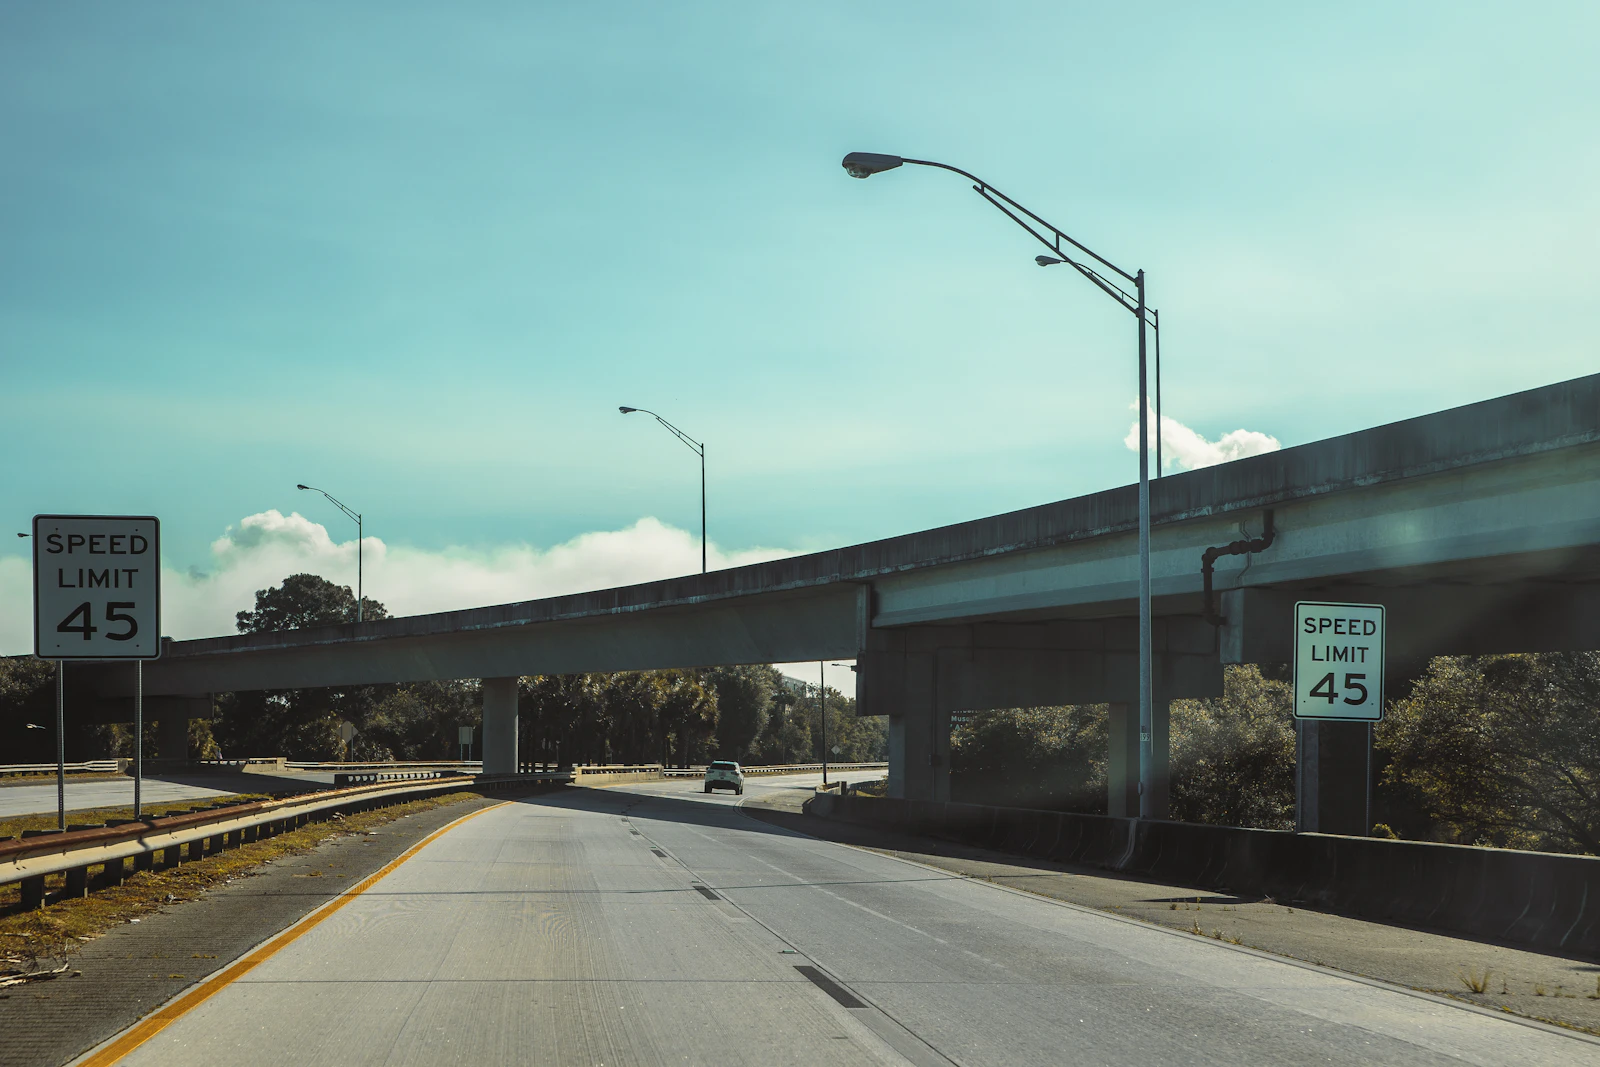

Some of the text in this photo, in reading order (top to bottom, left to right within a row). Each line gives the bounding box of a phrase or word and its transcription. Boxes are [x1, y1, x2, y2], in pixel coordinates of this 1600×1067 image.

[46, 533, 148, 555] SPEED
[58, 568, 139, 589] LIMIT
[56, 601, 138, 641] 45
[1303, 617, 1377, 636] SPEED
[1311, 645, 1369, 663] LIMIT
[1309, 672, 1368, 706] 45
